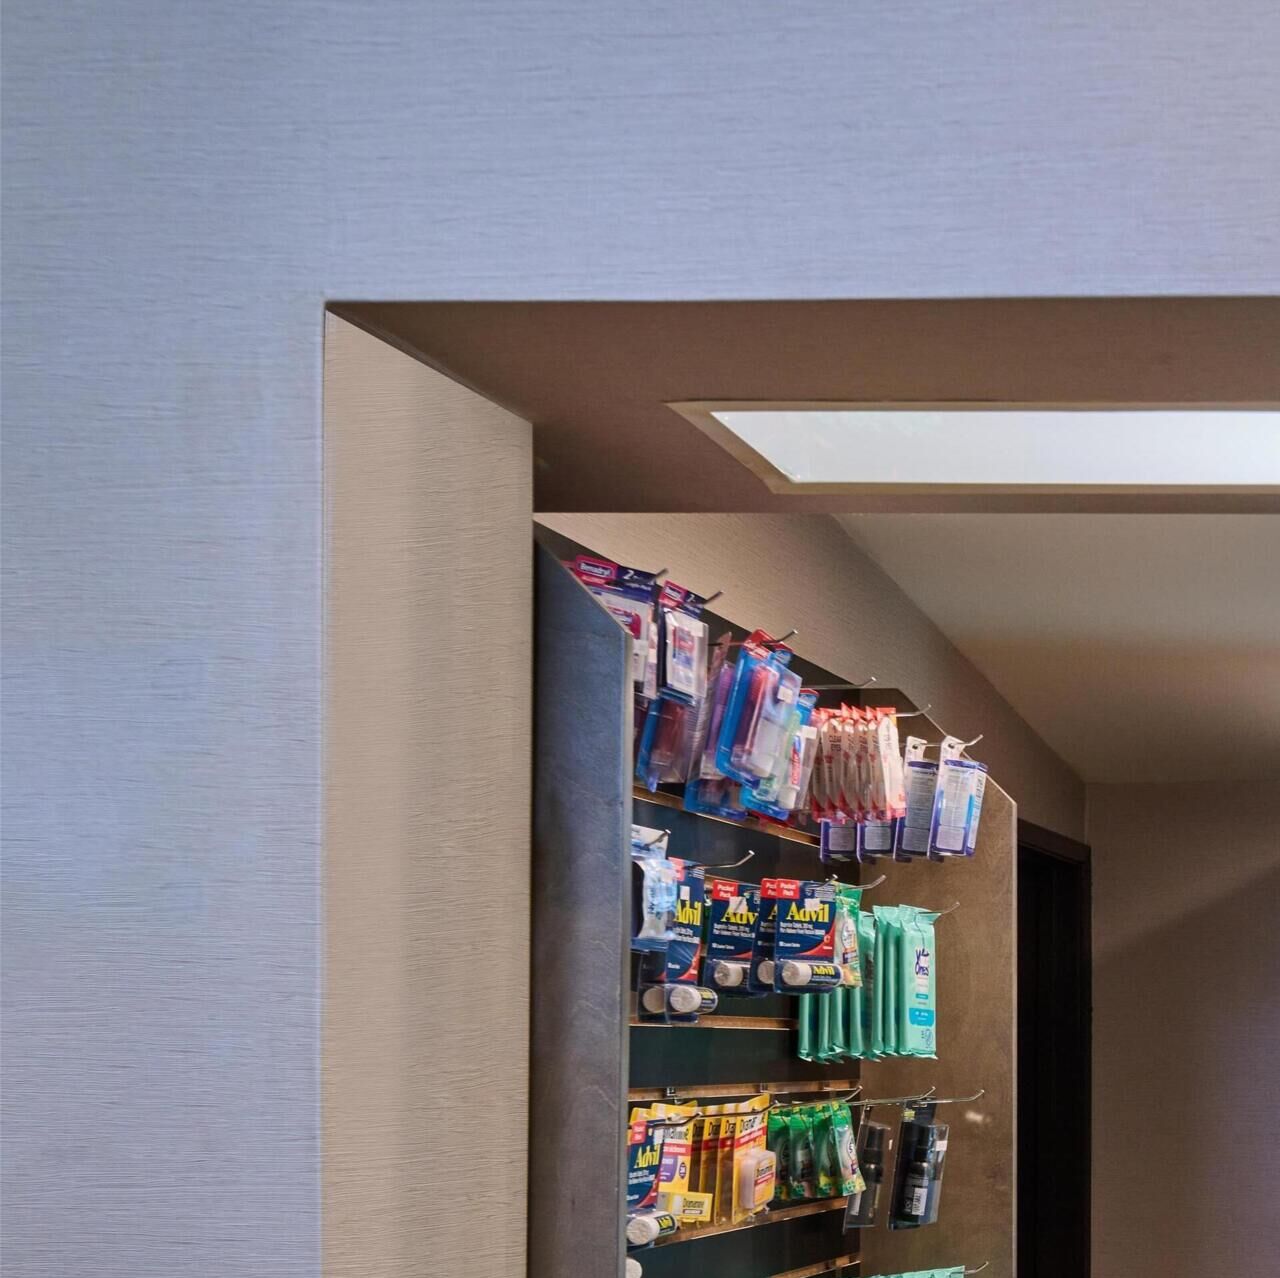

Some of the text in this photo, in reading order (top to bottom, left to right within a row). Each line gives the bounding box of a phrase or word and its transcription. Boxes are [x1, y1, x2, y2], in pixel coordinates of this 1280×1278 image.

[780, 882, 796, 890] Pocket
[673, 902, 702, 926] Advil
[786, 901, 830, 923] Advil
[634, 1143, 661, 1169] Advil
